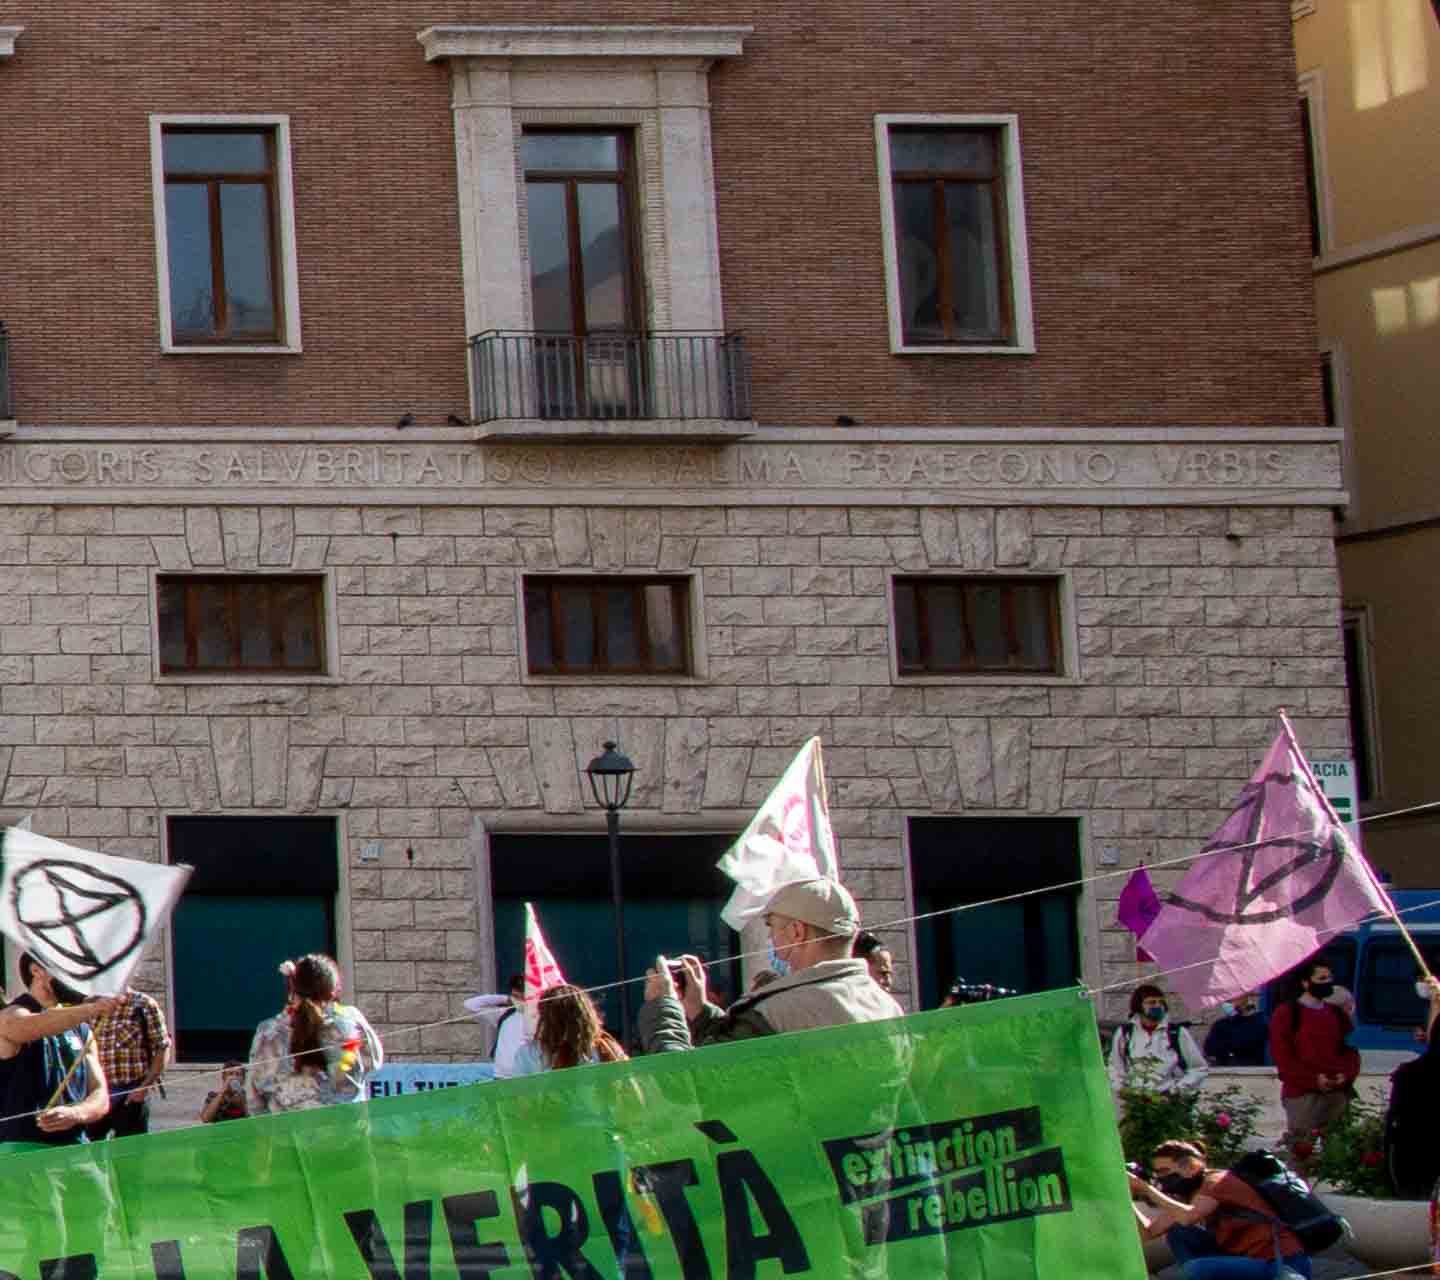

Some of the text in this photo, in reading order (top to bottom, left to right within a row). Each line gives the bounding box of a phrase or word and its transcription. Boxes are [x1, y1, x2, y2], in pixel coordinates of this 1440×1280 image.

[841, 450, 1121, 484] PRAECONIO
[1311, 762, 1349, 777] ACIA
[841, 1122, 1017, 1186] extinction
[906, 1163, 1064, 1232] rebellion
